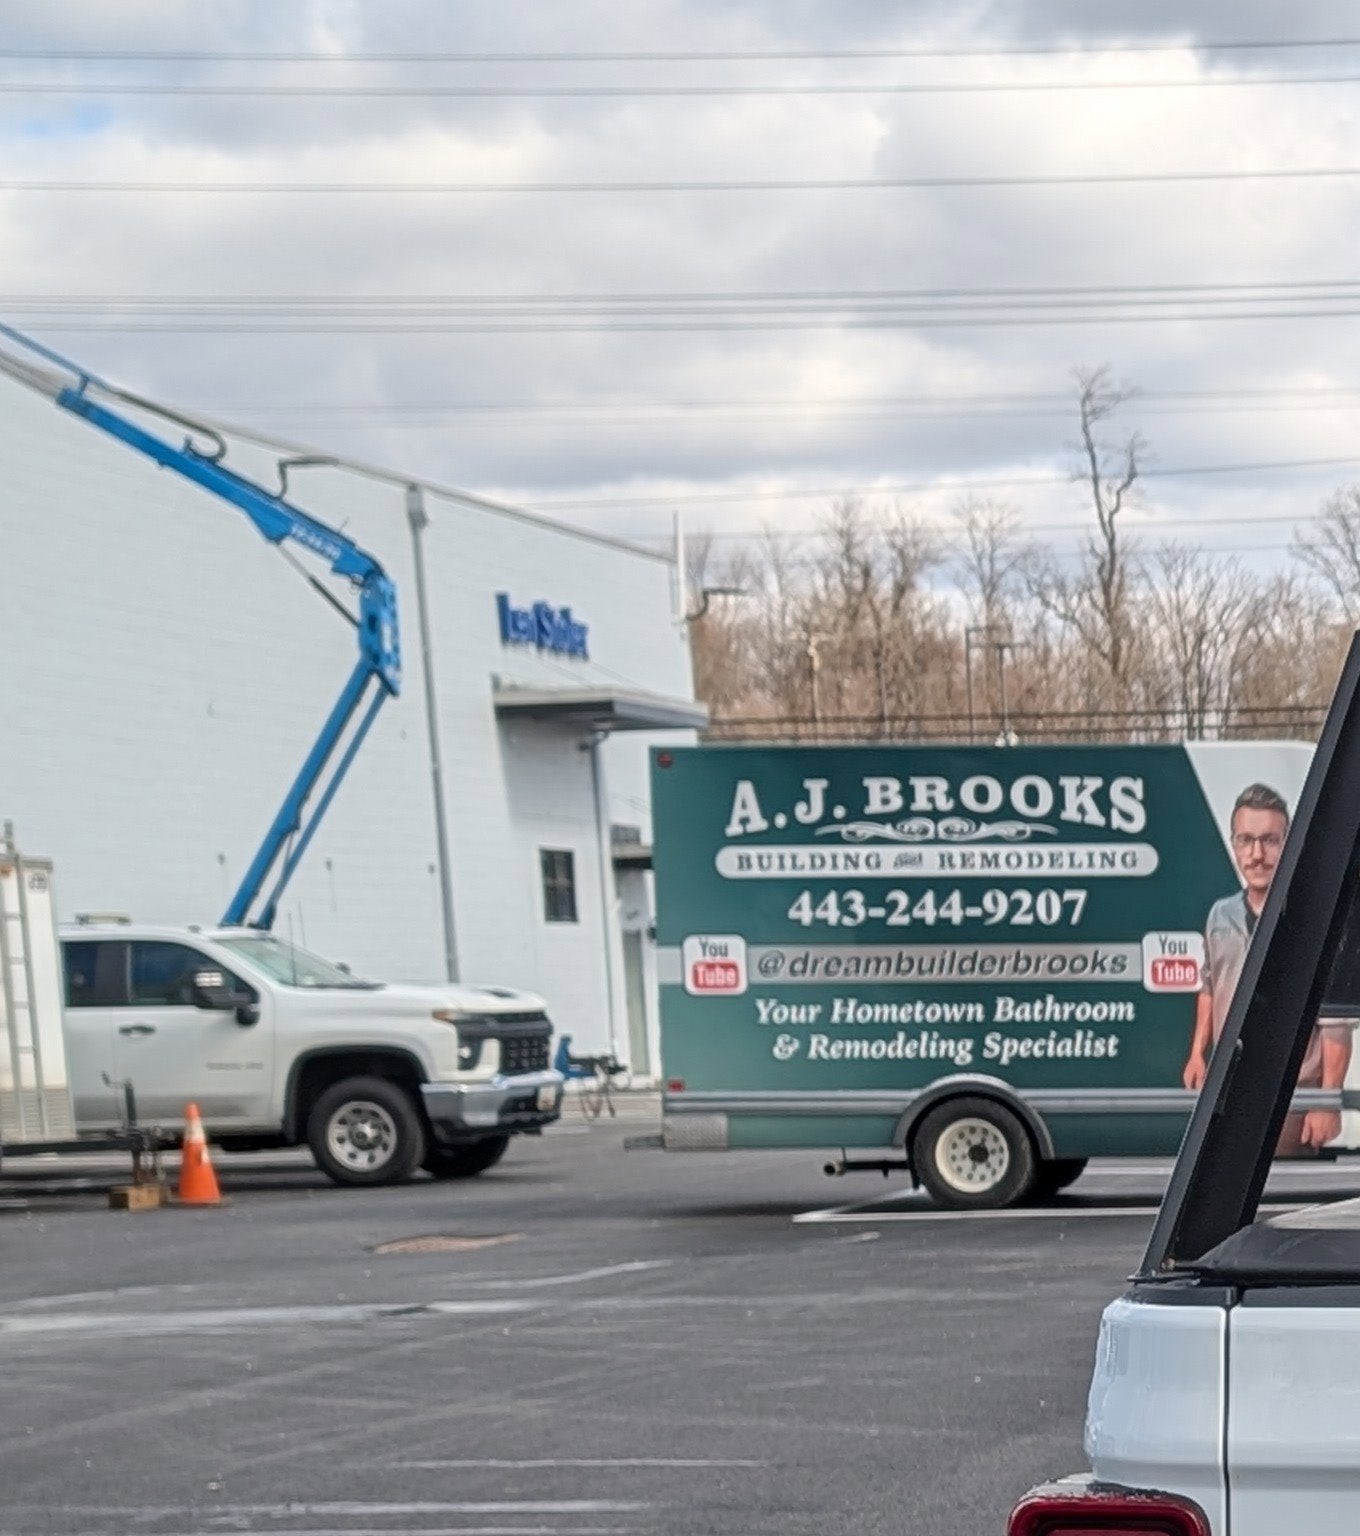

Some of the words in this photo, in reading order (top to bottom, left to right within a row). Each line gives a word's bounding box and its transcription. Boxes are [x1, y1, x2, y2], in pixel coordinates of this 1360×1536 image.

[724, 778, 847, 837] A.J.
[862, 775, 1147, 833] BROOKS
[736, 851, 882, 871] BUILDING
[938, 850, 1139, 870] REMODELING
[787, 888, 1088, 927] 443-244-9207
[700, 937, 729, 958] You
[1159, 934, 1188, 955] You
[697, 965, 738, 986] Tube
[757, 949, 1129, 978] @dreambuilderbrooks
[1155, 959, 1196, 983] Tube
[755, 998, 823, 1025] Your
[830, 997, 986, 1024] Hometown
[993, 994, 1136, 1023] Bathroom
[772, 1033, 800, 1060] &
[806, 1030, 975, 1067] Remodeling
[982, 1028, 1120, 1066] Specialist
